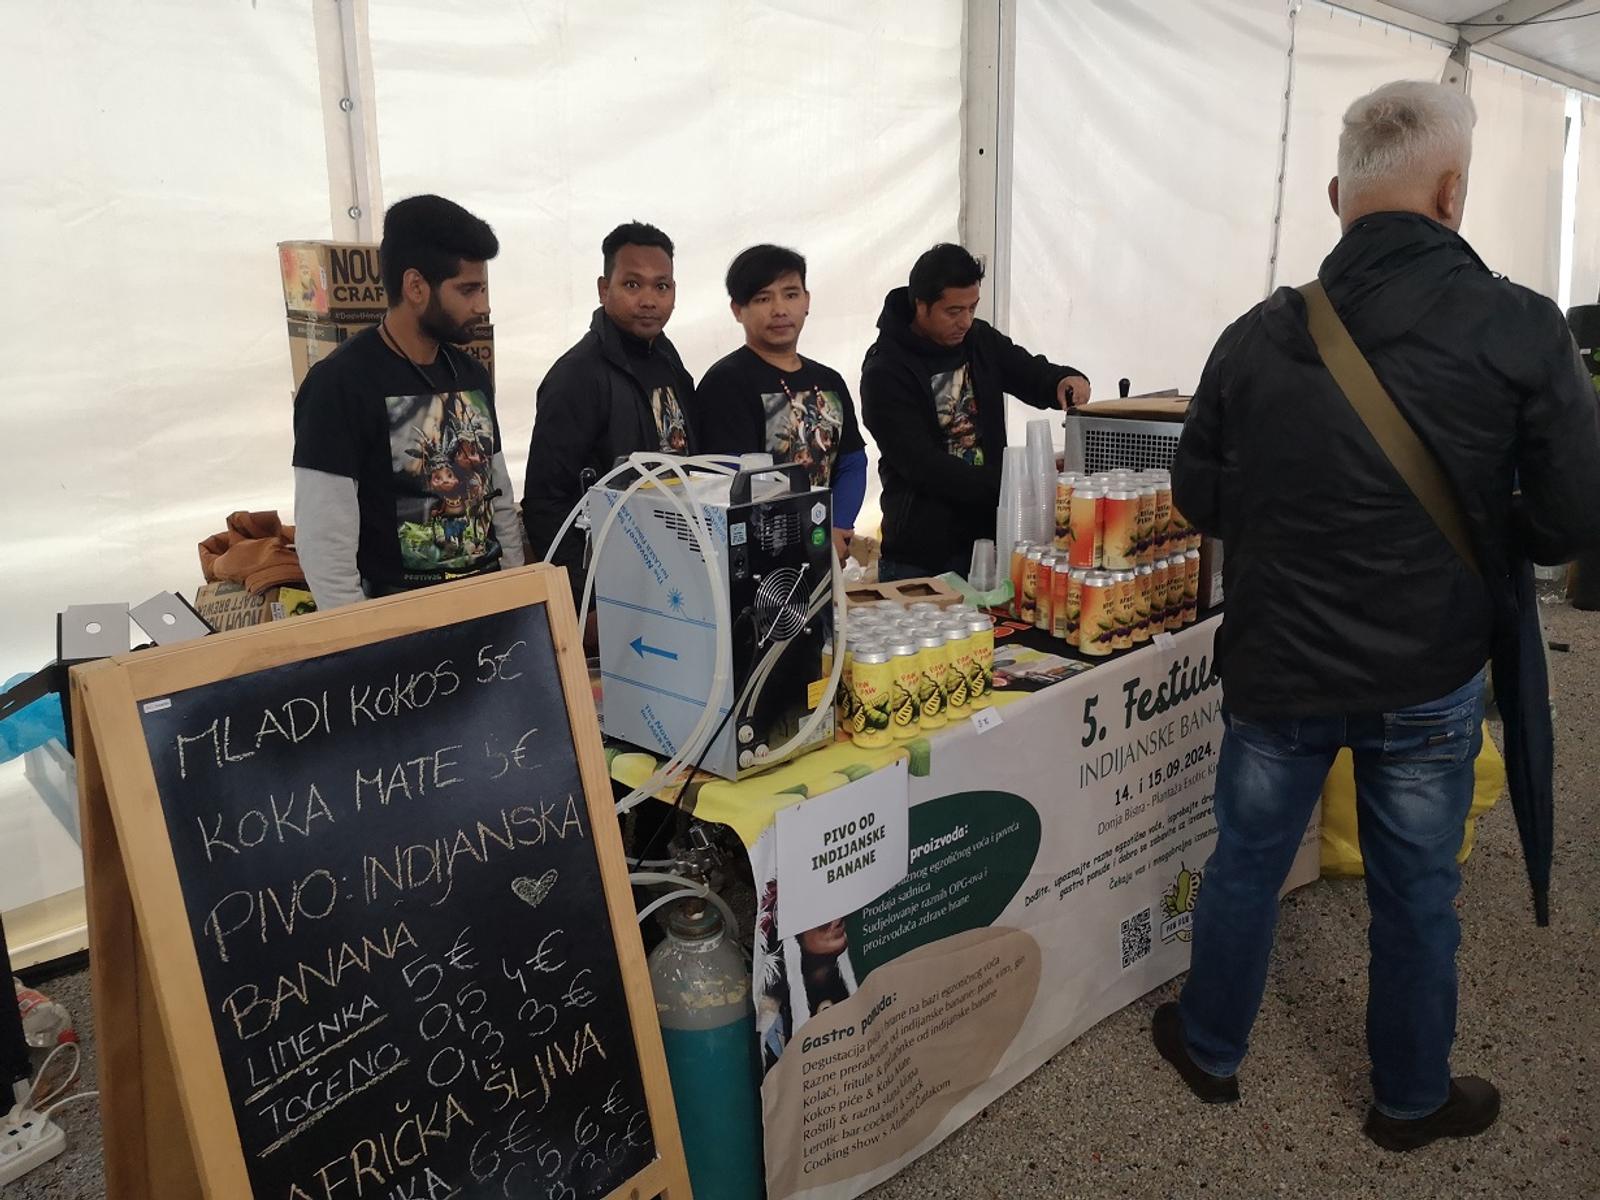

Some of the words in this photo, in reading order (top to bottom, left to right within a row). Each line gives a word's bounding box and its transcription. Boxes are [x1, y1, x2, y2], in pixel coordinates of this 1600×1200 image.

[177, 690, 331, 779] MLADI
[350, 659, 461, 727] KOKOS
[1081, 694, 1107, 748] 5.
[1080, 721, 1175, 789] INDIJANSKE
[1115, 783, 1134, 806] 14.
[1138, 778, 1143, 794] i
[1148, 741, 1216, 789] 15.09.2024.
[197, 782, 336, 863] KOKA
[356, 744, 465, 813] MATE
[1097, 813, 1123, 836] Donja
[1124, 801, 1146, 823] Bistra
[811, 825, 886, 871] INDIJANSKE
[823, 821, 857, 846] PIVO
[859, 812, 875, 831] OD
[909, 824, 969, 865] proizvoda:
[363, 793, 584, 906] INDIJANSKA
[826, 849, 877, 884] BANANE
[1054, 858, 1091, 887] upoznajte
[862, 896, 897, 920] Prodaja
[897, 881, 932, 901] sadnica
[862, 902, 920, 937] Sudjelovanje
[222, 921, 419, 1040] BANANA
[247, 994, 380, 1088] LIMENKA
[801, 1025, 855, 1054] Gastro
[802, 1043, 866, 1076] Degustacija
[484, 1022, 607, 1113] ŠLJIVA
[802, 1071, 837, 1093] Razne
[843, 1071, 874, 1093] fritule
[258, 1042, 401, 1134] TOČENO
[802, 1103, 836, 1126] Kokos
[839, 1092, 863, 1113] piće
[865, 1086, 874, 1100] &
[802, 1118, 836, 1141] Roštilj
[839, 1113, 849, 1125] &
[852, 1101, 881, 1121] razna
[842, 1126, 861, 1140] bar
[802, 1145, 850, 1175] Cooking
[851, 1132, 881, 1151] show
